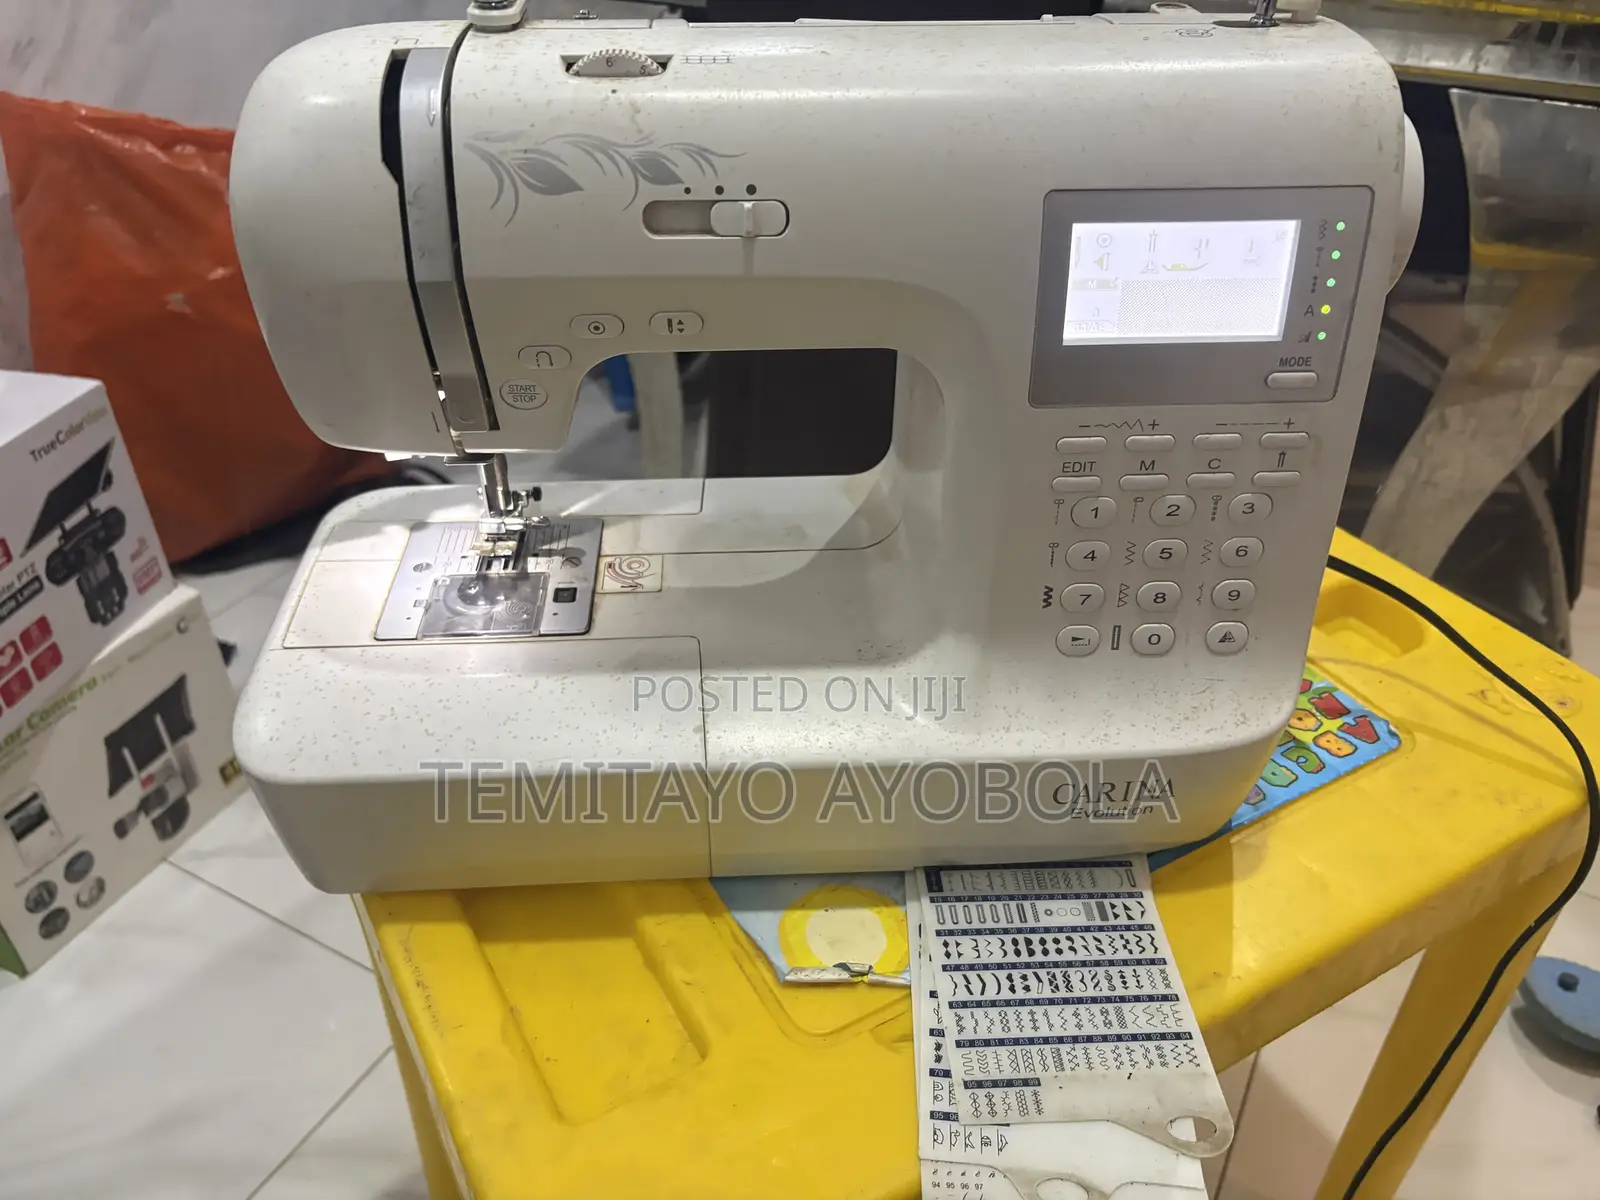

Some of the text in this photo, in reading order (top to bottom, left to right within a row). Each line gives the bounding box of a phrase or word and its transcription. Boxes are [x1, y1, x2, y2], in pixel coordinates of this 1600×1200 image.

[1304, 304, 1314, 317] A
[1279, 356, 1312, 367] MODE
[1062, 458, 1221, 473] EDIT M C
[1090, 503, 1255, 519] 1 2 3
[1084, 546, 1248, 562] 4 5 6
[1079, 590, 1240, 605] 7 8 9
[1148, 634, 1161, 645] 0
[1052, 778, 1176, 804] CARINA
